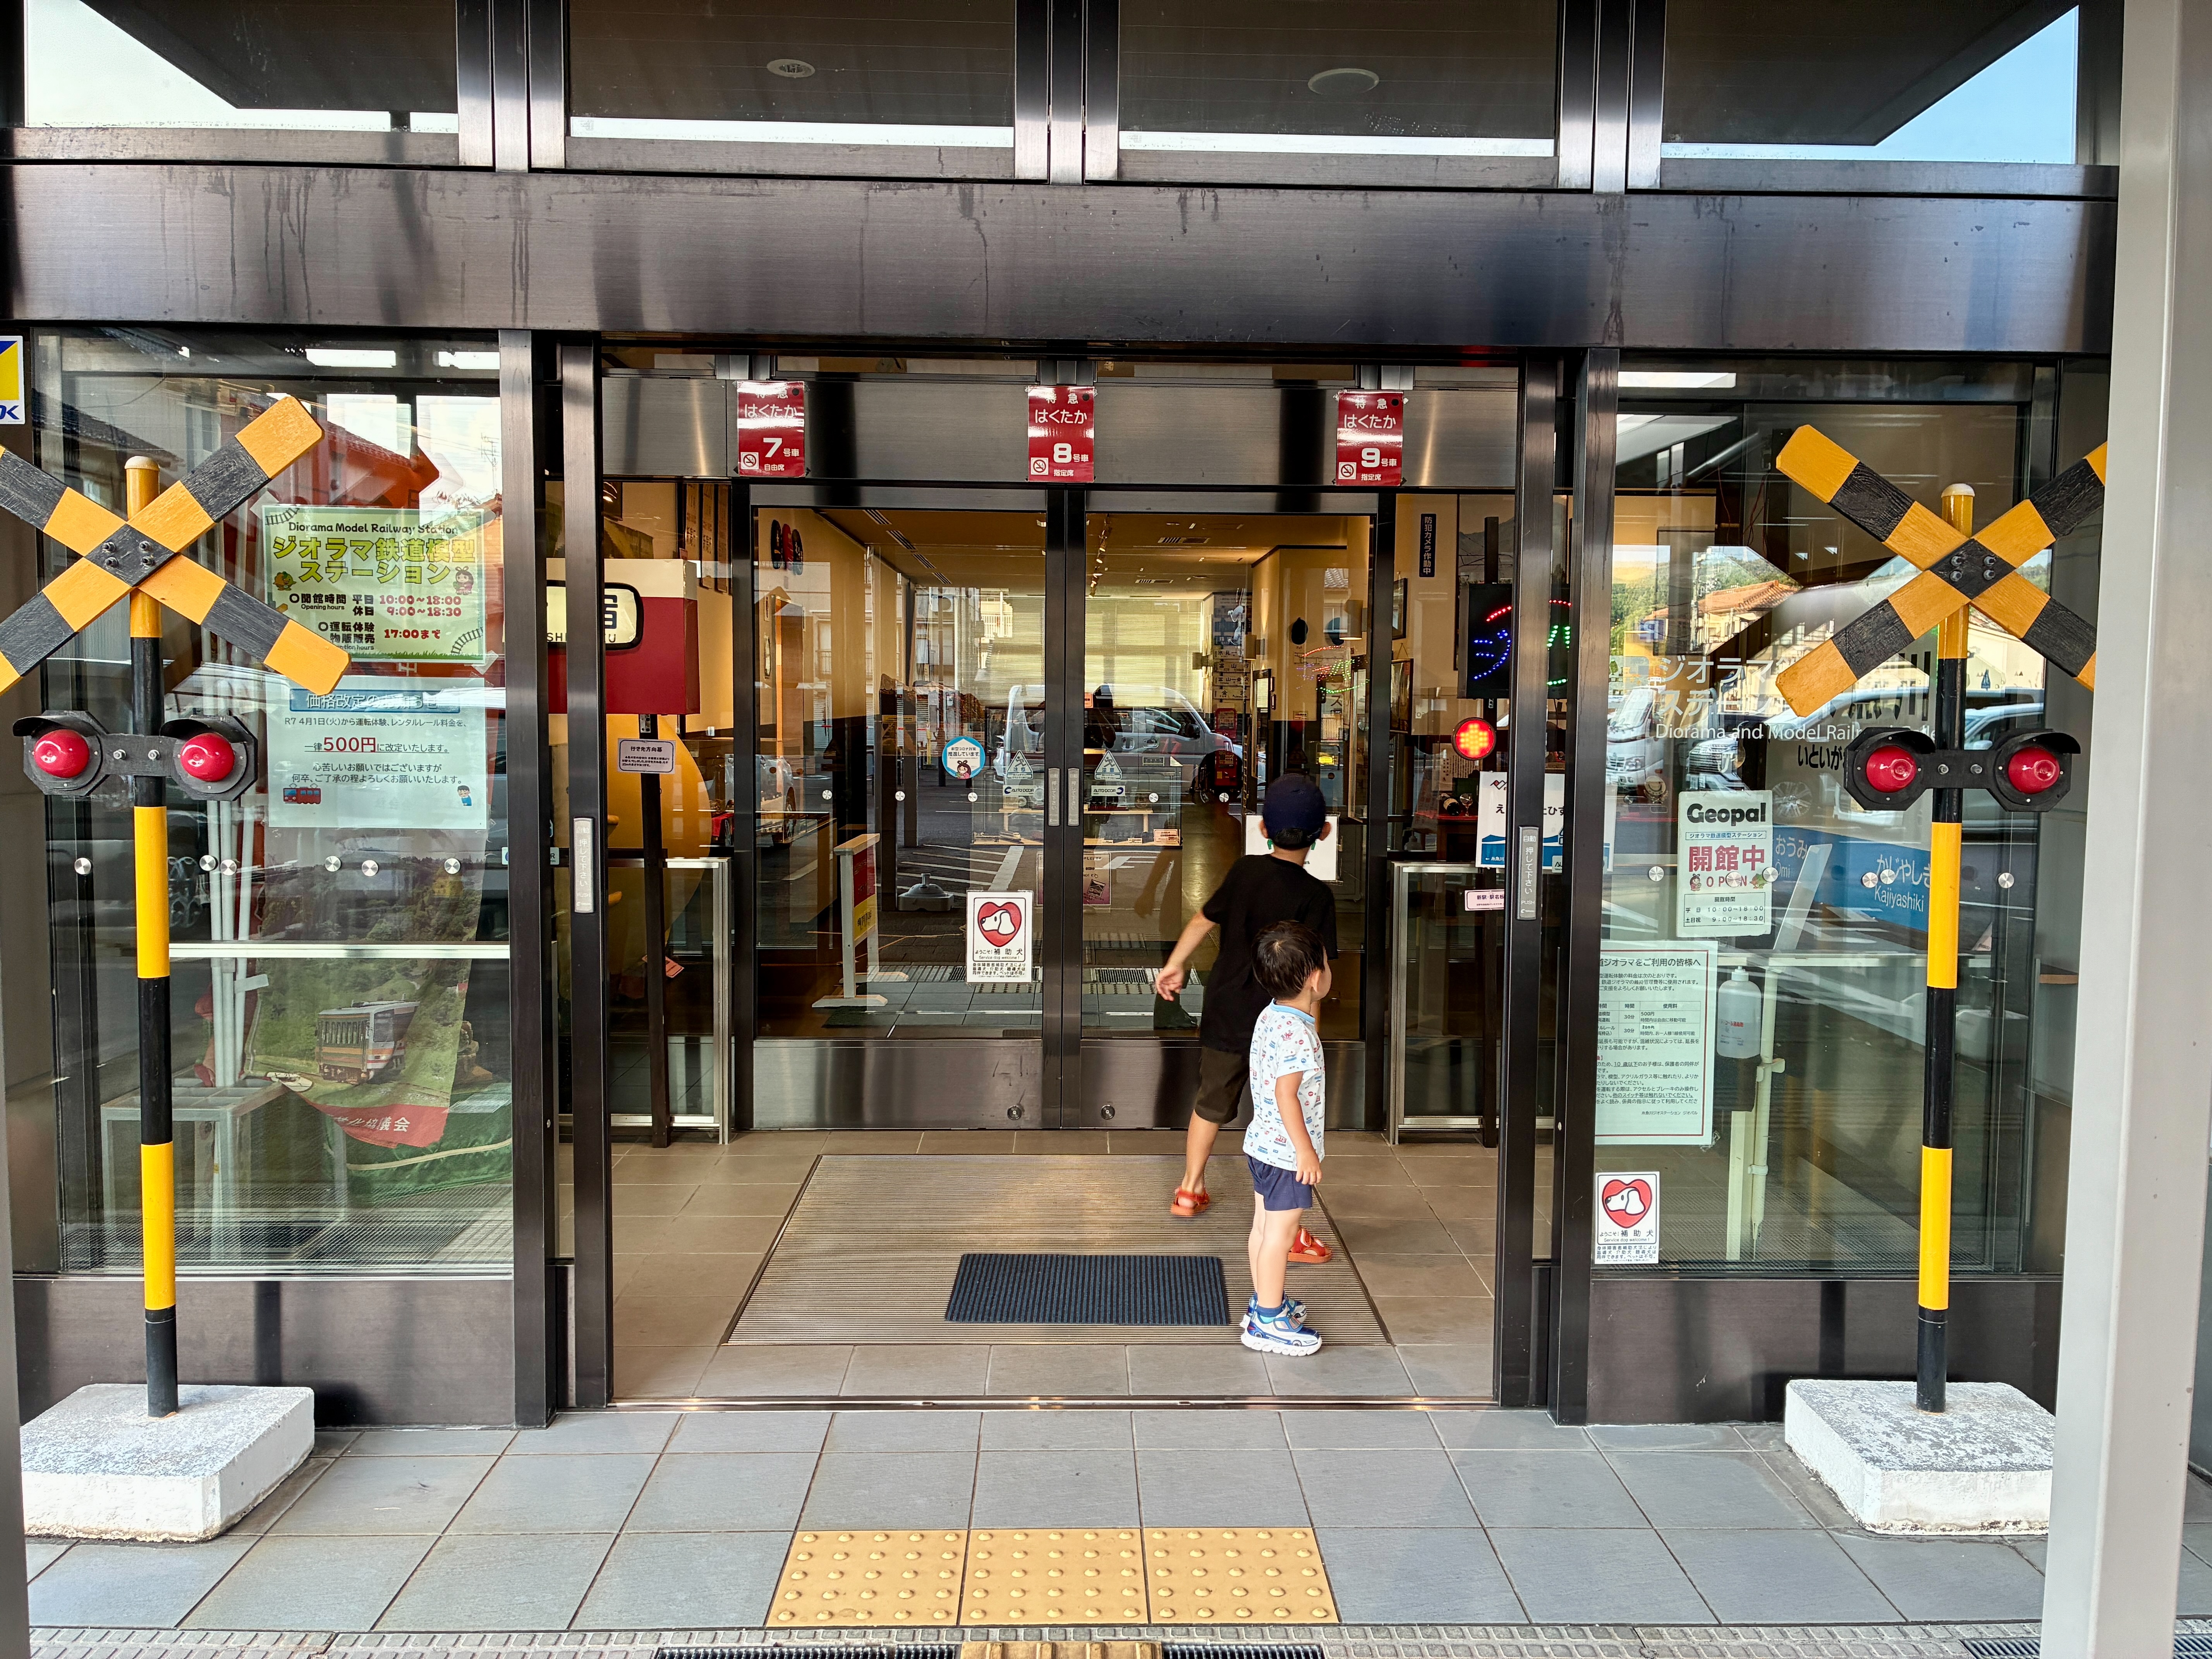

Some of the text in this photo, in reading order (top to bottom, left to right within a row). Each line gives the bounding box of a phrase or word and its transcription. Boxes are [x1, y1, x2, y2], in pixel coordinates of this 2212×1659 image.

[744, 404, 797, 418] はくたか
[1355, 398, 1388, 409] 特急
[1035, 409, 1087, 424] はくたか
[1344, 414, 1396, 429] はくたか
[289, 522, 333, 532] Diorama
[335, 523, 368, 533] Model
[372, 524, 415, 535] Railway
[273, 535, 476, 563] ジオラマ鉄道模型
[1423, 517, 1432, 575] 防犯カメラ作動中
[299, 561, 451, 584] ステーション
[352, 594, 374, 605] 平日
[352, 606, 374, 617] 休日
[384, 629, 441, 640] 17:00まで
[1656, 723, 1726, 739] Diorama
[1731, 723, 1762, 739] and
[1769, 724, 1820, 740] Model
[304, 737, 449, 753] 一律500円に改定いたします。
[1798, 744, 1845, 771] いといが
[313, 763, 442, 773] 心苦しいお願いではございますが
[292, 773, 462, 785] 何卒、ご了承の程よろしくお願いいたします。
[1687, 802, 1766, 826] Geopal
[579, 839, 587, 887] 押して下さい
[1689, 845, 1765, 872] 開館中
[1525, 847, 1534, 895] 押して下さい
[1706, 875, 1747, 887] OPN
[1875, 885, 1924, 912] Kajiyashiki
